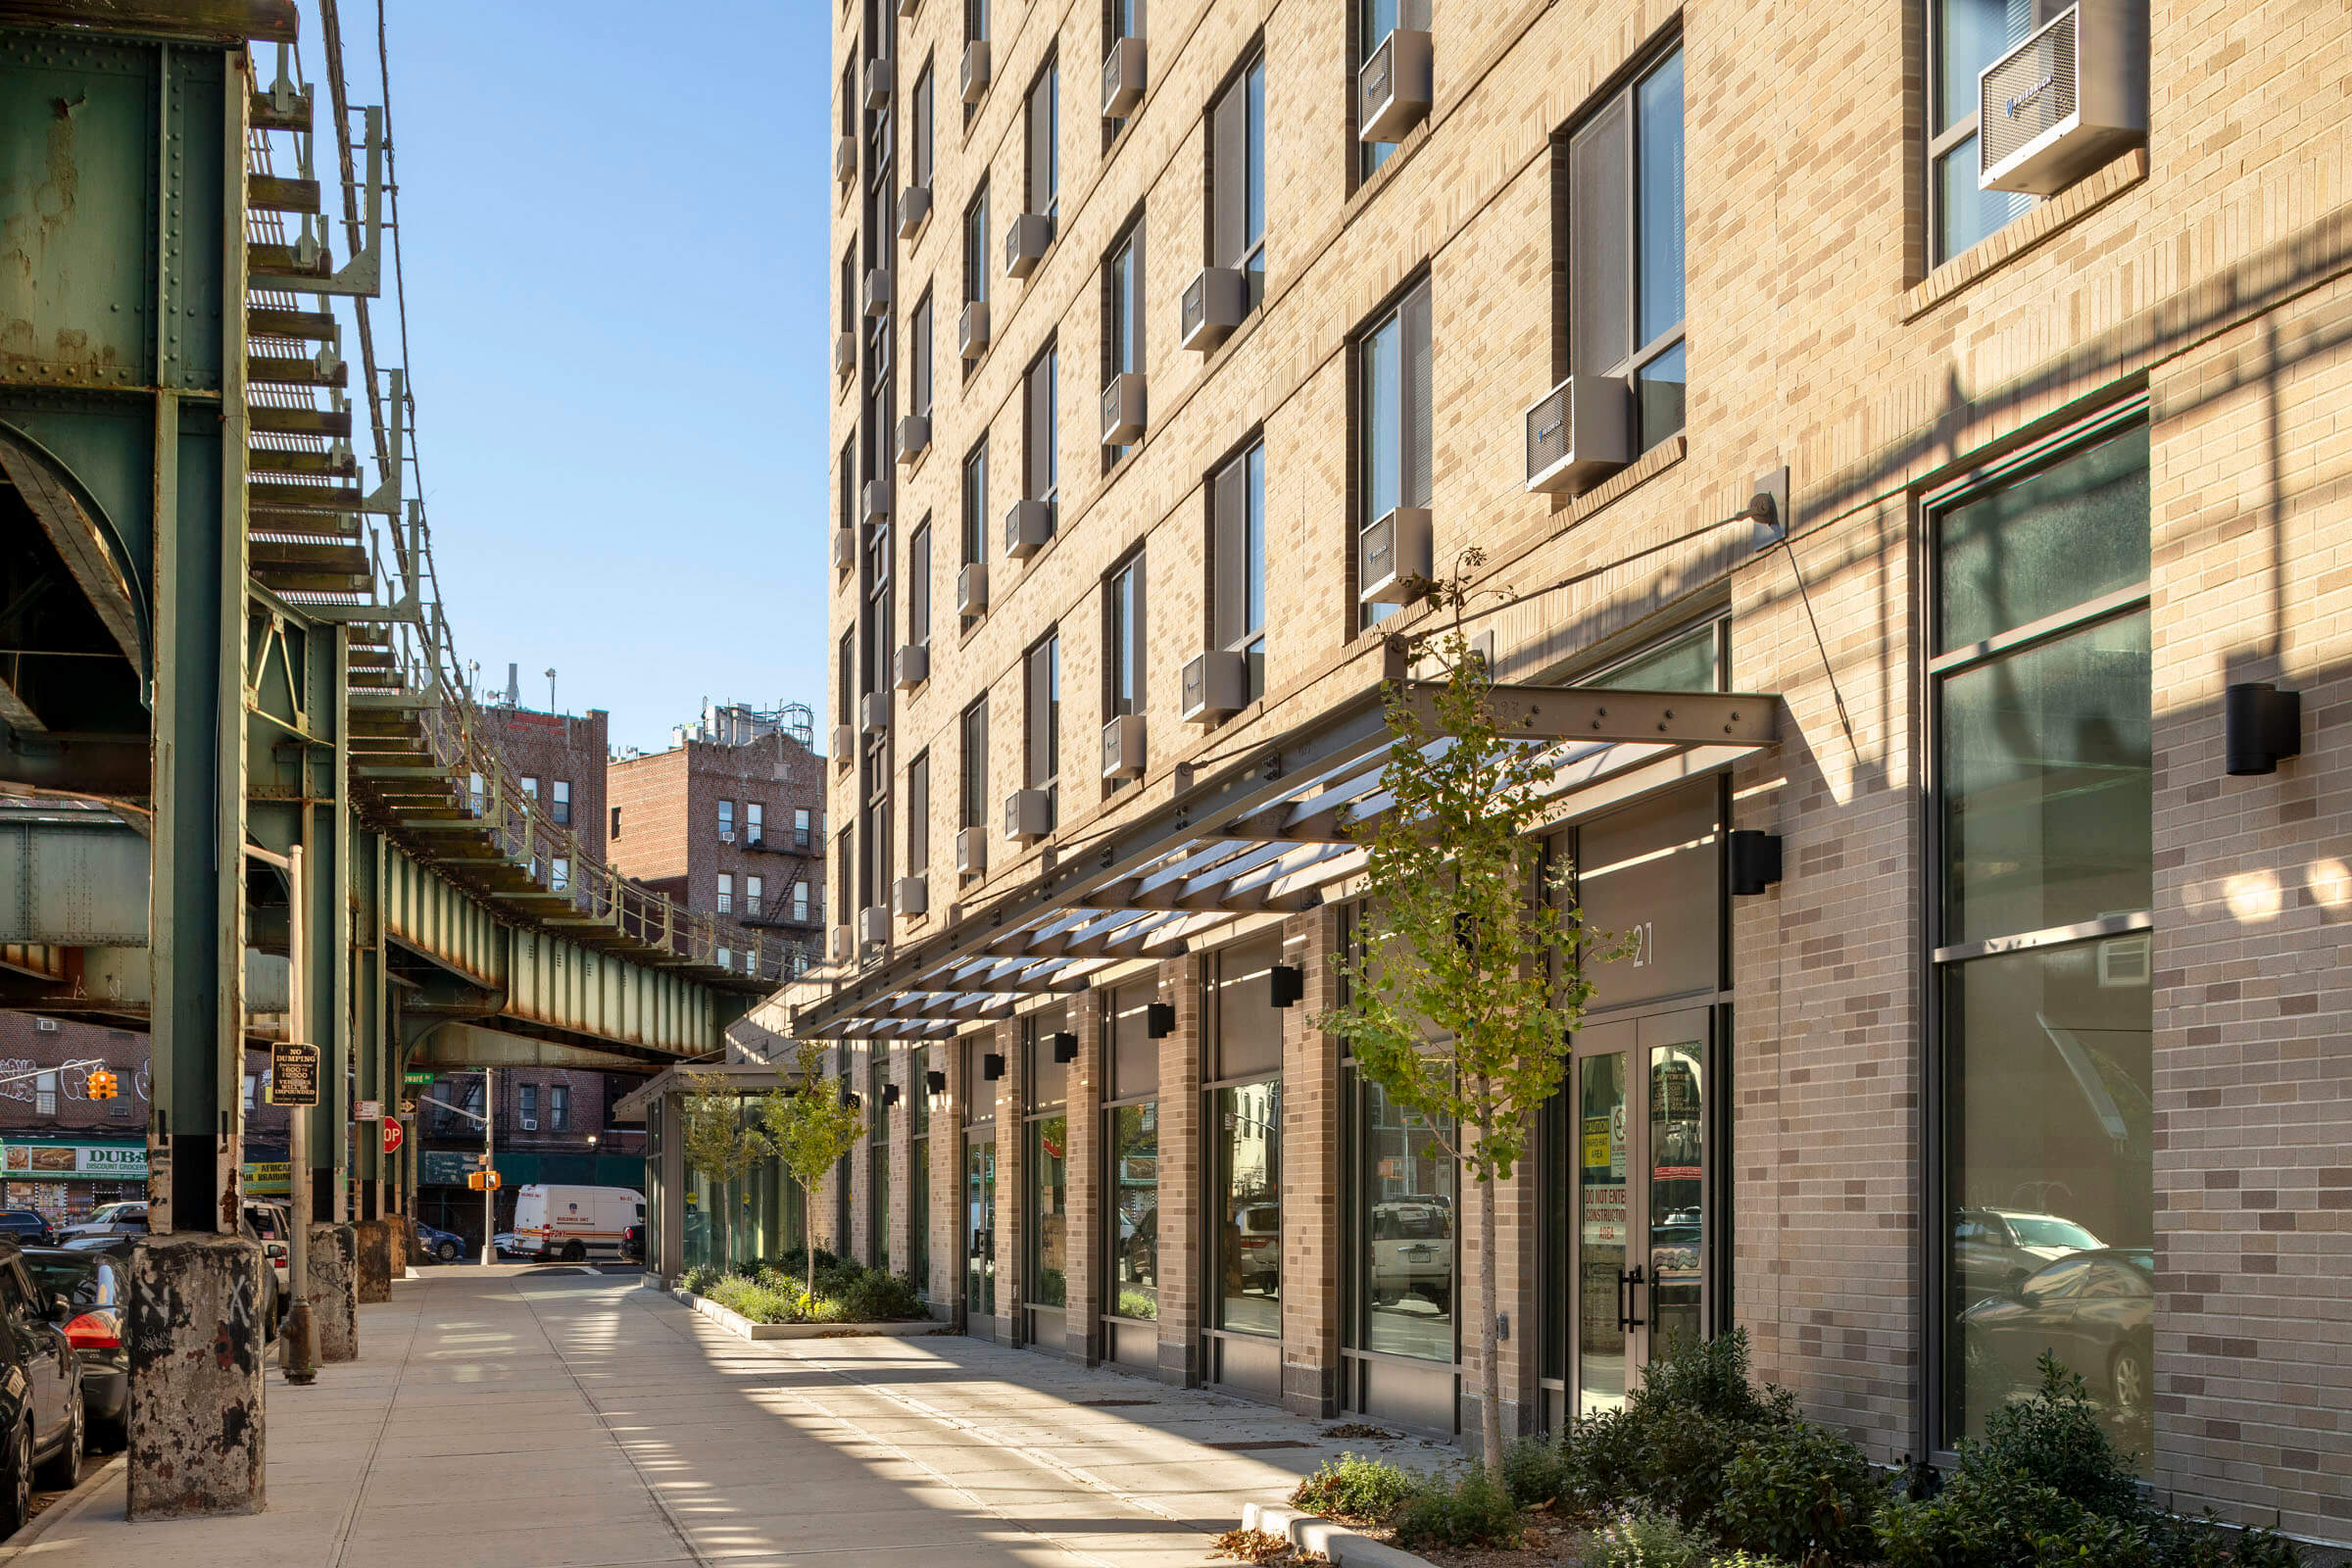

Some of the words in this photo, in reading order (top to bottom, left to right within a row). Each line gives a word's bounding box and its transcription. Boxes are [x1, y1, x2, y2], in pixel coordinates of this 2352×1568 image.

[1633, 921, 1652, 967] 21
[1585, 1189, 1594, 1204] DO
[1595, 1189, 1608, 1204] NOT
[1598, 1226, 1615, 1240] AREA
